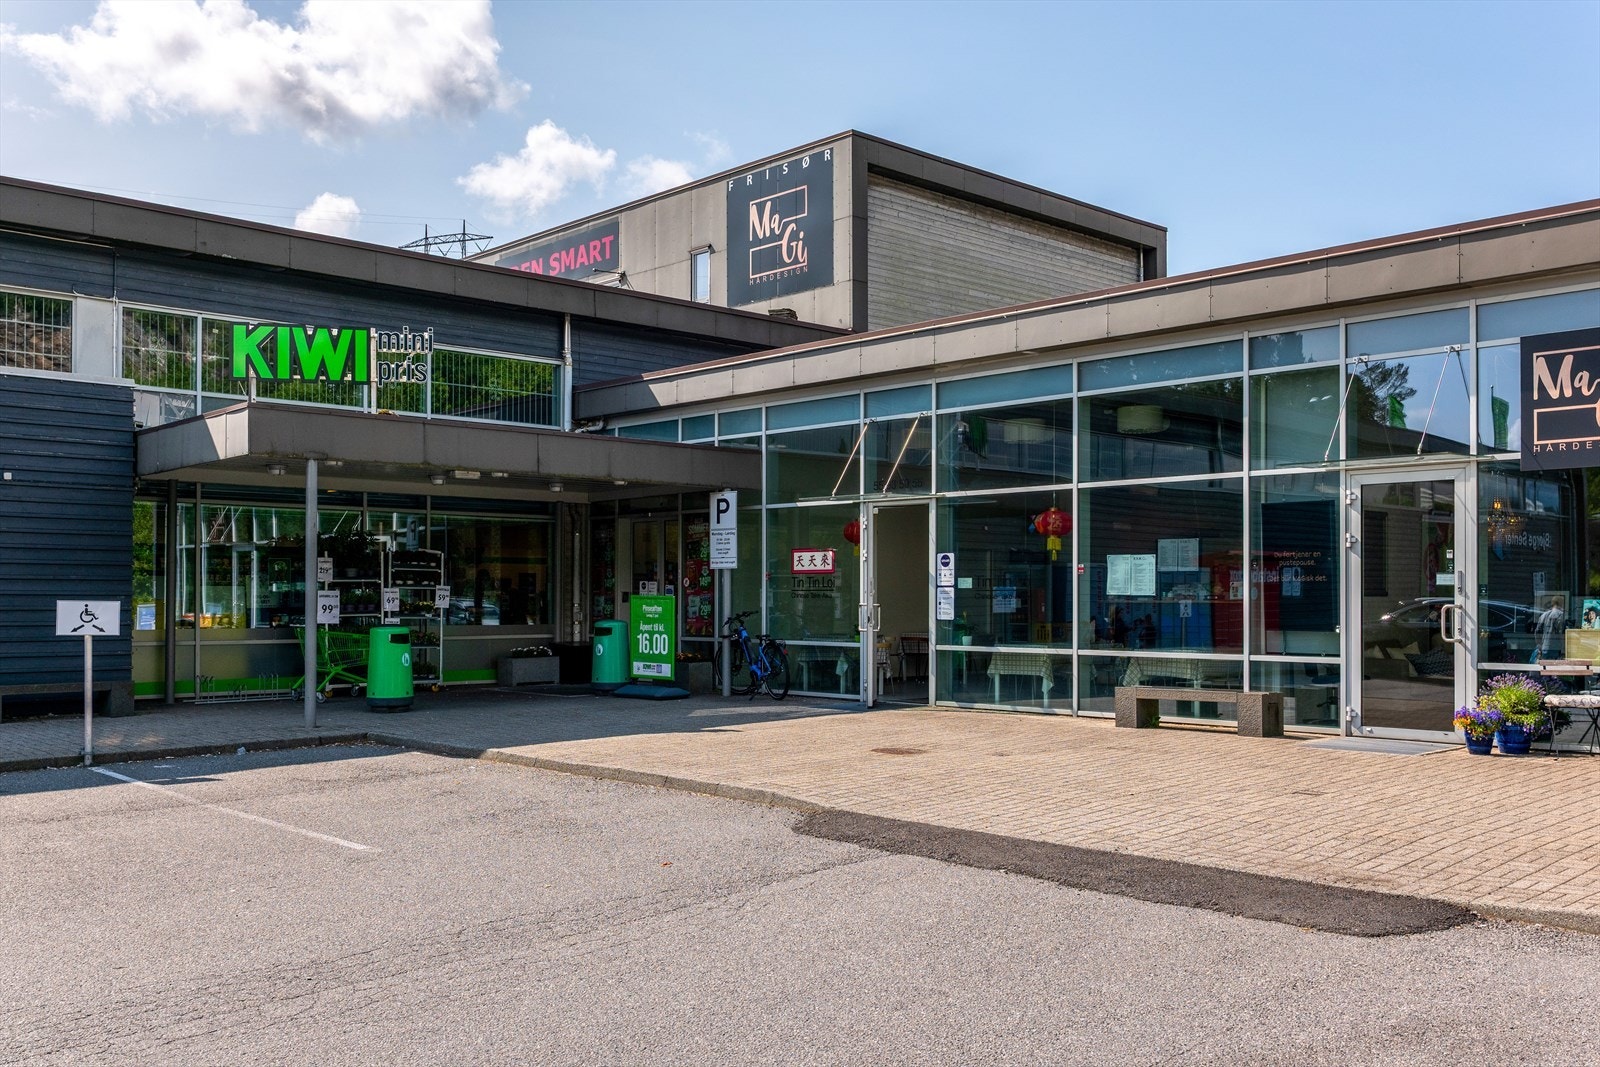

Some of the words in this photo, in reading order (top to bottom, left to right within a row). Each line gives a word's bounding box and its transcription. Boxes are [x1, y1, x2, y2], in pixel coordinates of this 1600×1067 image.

[728, 149, 831, 192] FRISØR
[750, 200, 782, 241] Ma
[549, 235, 614, 277] SMART
[782, 222, 808, 264] Gi
[749, 266, 808, 286] HARDESIGN
[232, 324, 368, 382] KIWI
[377, 326, 434, 353] mini
[377, 355, 427, 387] pris
[1533, 354, 1596, 400] Ma
[1533, 441, 1600, 453] HARDE
[716, 498, 730, 524] P
[636, 633, 669, 655] 16.00
